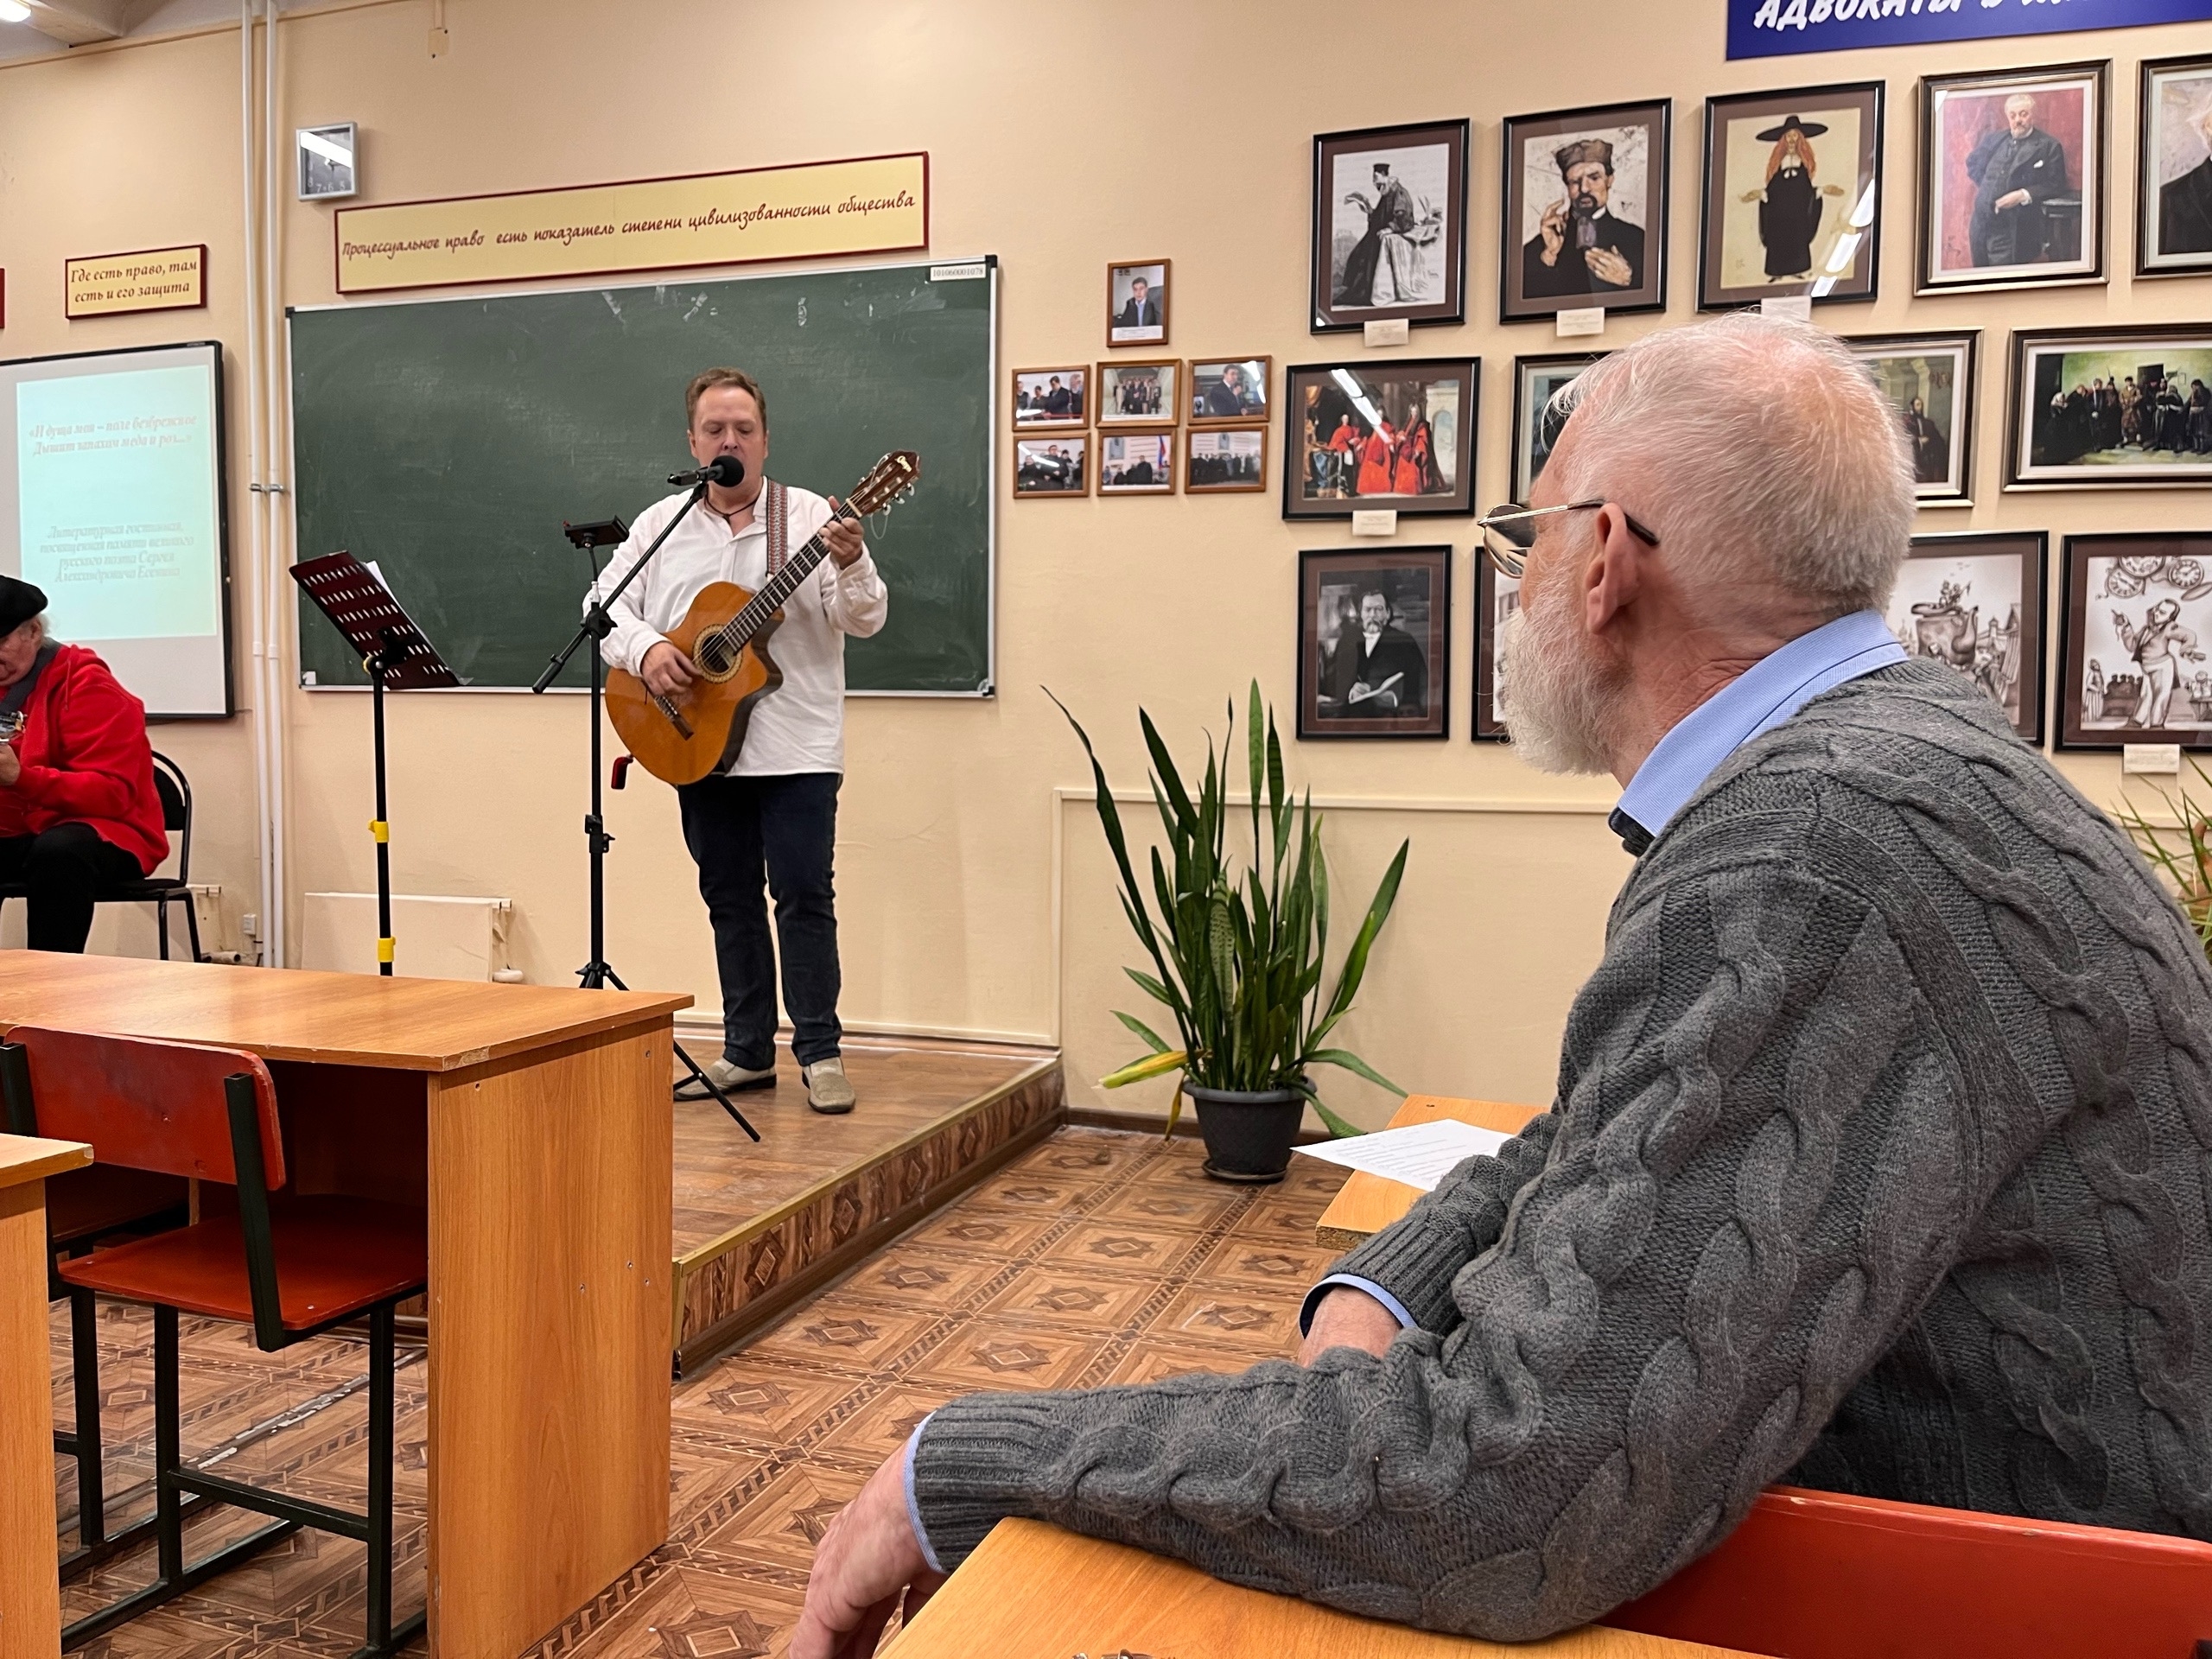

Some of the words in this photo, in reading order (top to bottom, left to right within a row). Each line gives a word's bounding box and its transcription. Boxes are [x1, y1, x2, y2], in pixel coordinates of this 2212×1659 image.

[342, 238, 440, 261] Процессуальное
[445, 229, 485, 254] право
[496, 232, 528, 245] есть
[534, 224, 615, 246] показатель
[622, 217, 682, 234] степени
[689, 202, 830, 232] цивилизованности
[838, 190, 916, 216] общества
[71, 270, 91, 283] Где
[93, 269, 123, 280] есть
[125, 264, 166, 281] право,
[168, 261, 197, 273] там
[74, 289, 104, 302] есть
[106, 289, 114, 299] и
[117, 287, 135, 298] его
[137, 283, 189, 298] защита
